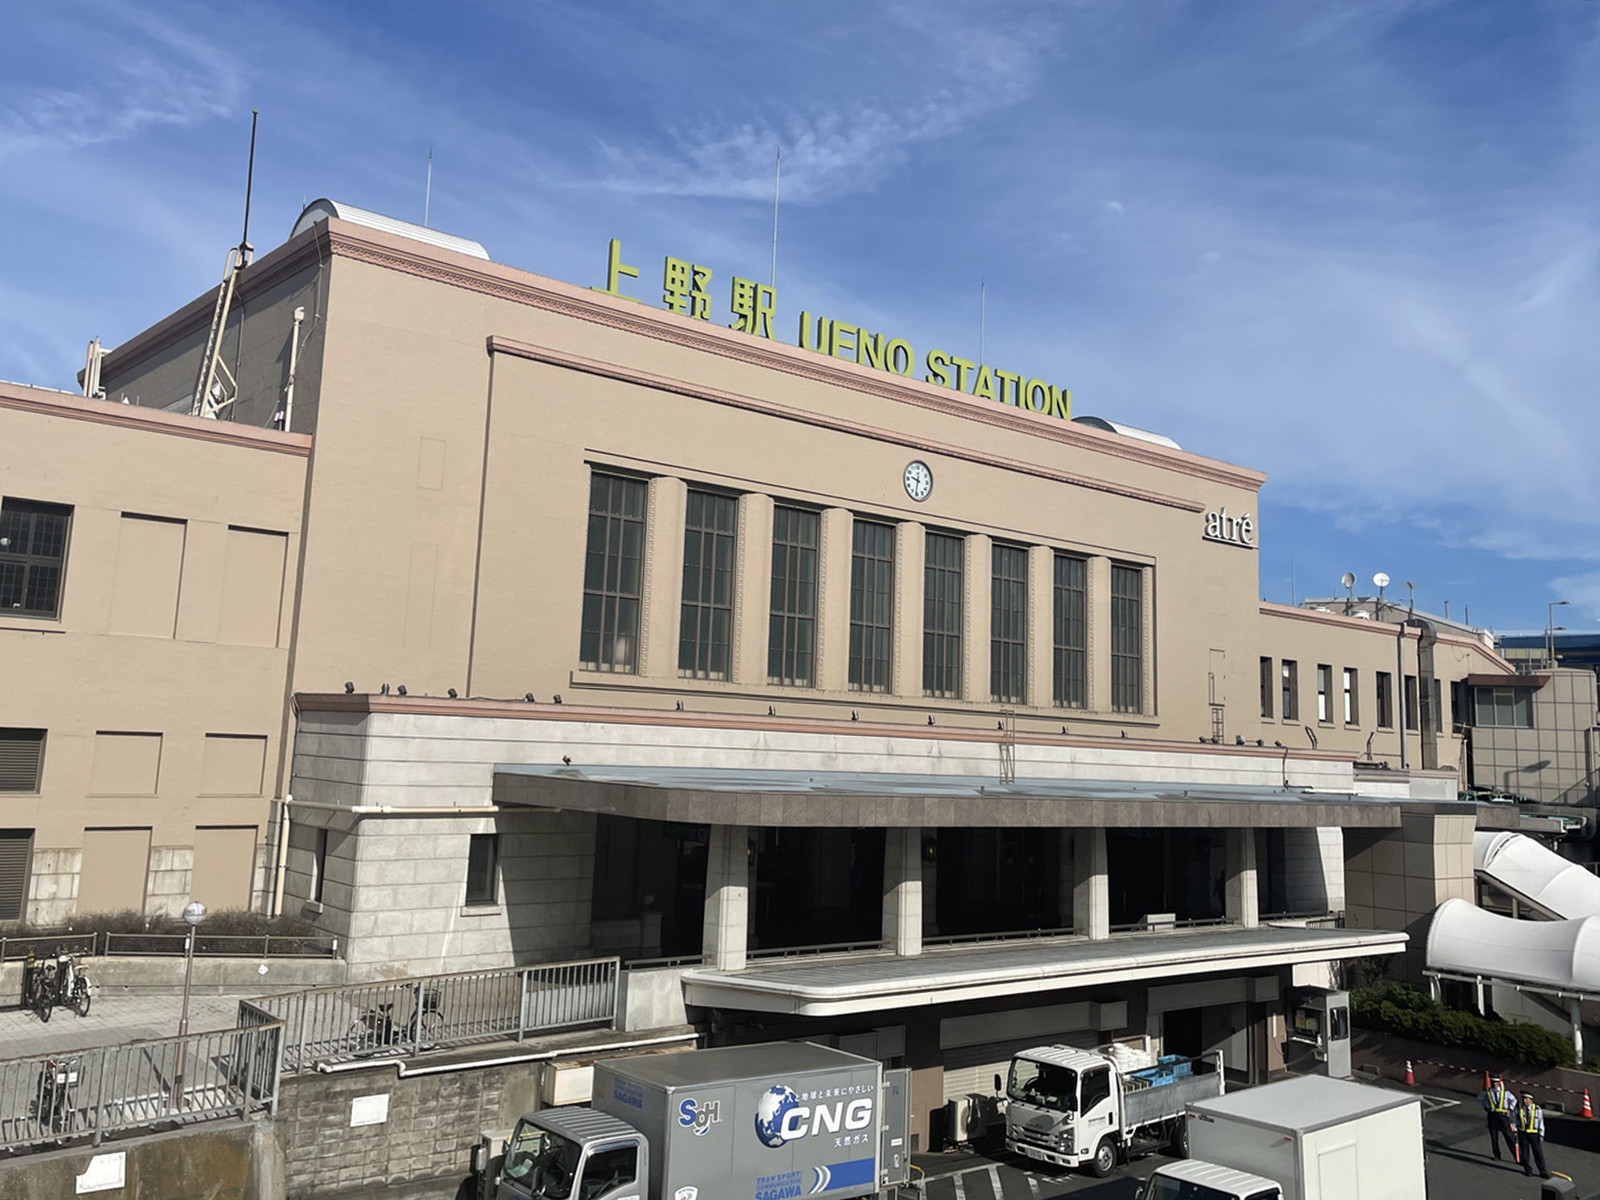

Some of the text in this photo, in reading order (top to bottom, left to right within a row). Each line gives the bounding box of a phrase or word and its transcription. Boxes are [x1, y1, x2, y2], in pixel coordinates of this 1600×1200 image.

[590, 238, 776, 340] 上野駅
[799, 311, 1072, 421] UENO STATION
[1204, 506, 1254, 545] atré
[780, 1098, 873, 1140] CNG
[834, 1134, 869, 1148] 天然ガス
[755, 1184, 802, 1200] SAGAWA
